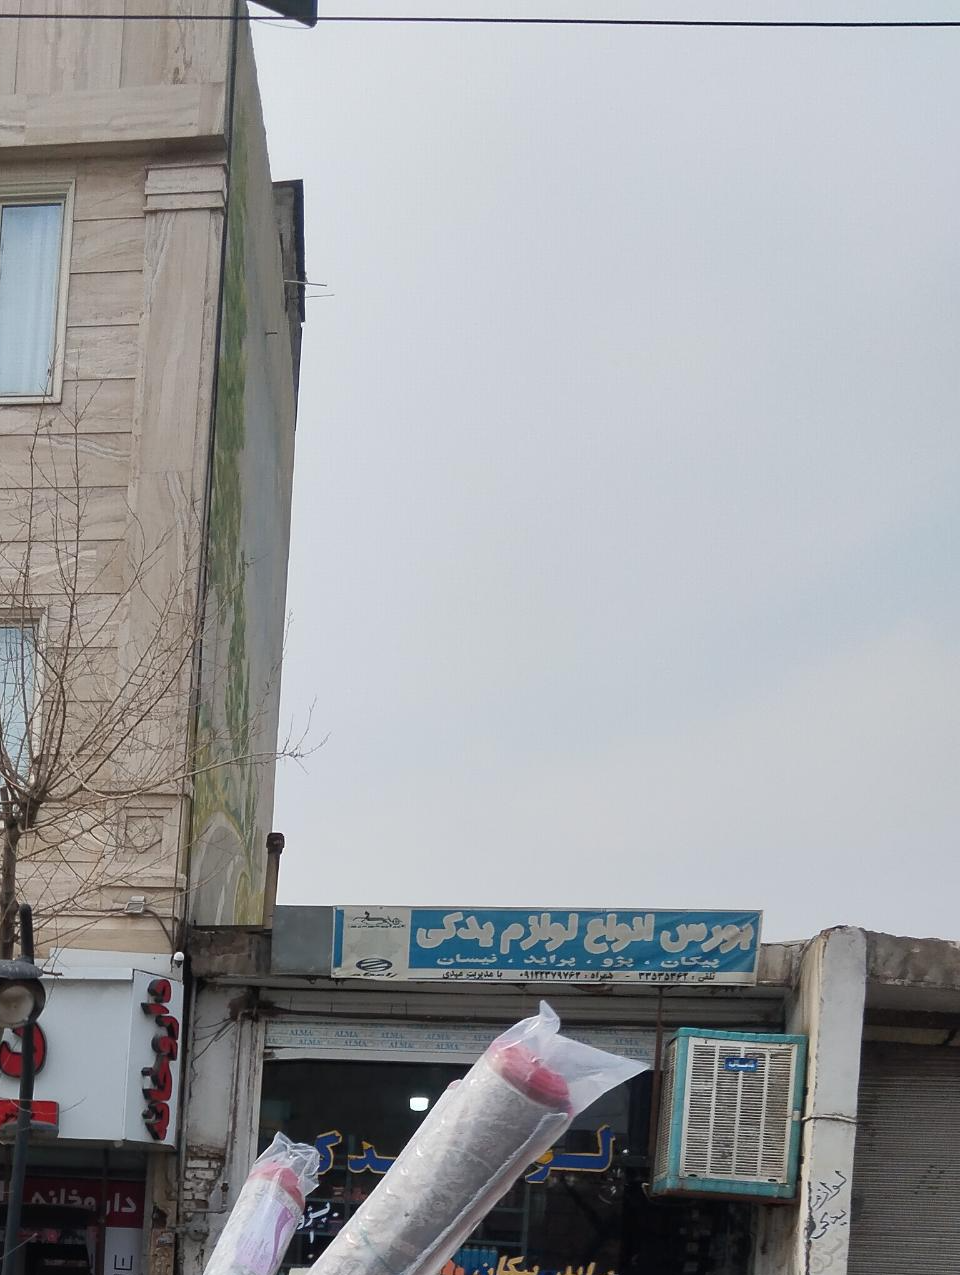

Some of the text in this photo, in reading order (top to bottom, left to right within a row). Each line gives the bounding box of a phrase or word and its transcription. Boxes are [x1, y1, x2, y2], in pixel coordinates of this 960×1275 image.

[416, 911, 754, 955] بورس انواع لوازم یدکی
[436, 953, 720, 969] پیکان پژو پراید نیسان
[140, 978, 180, 1141] داروخانه
[31, 1188, 138, 1214] داروخانه
